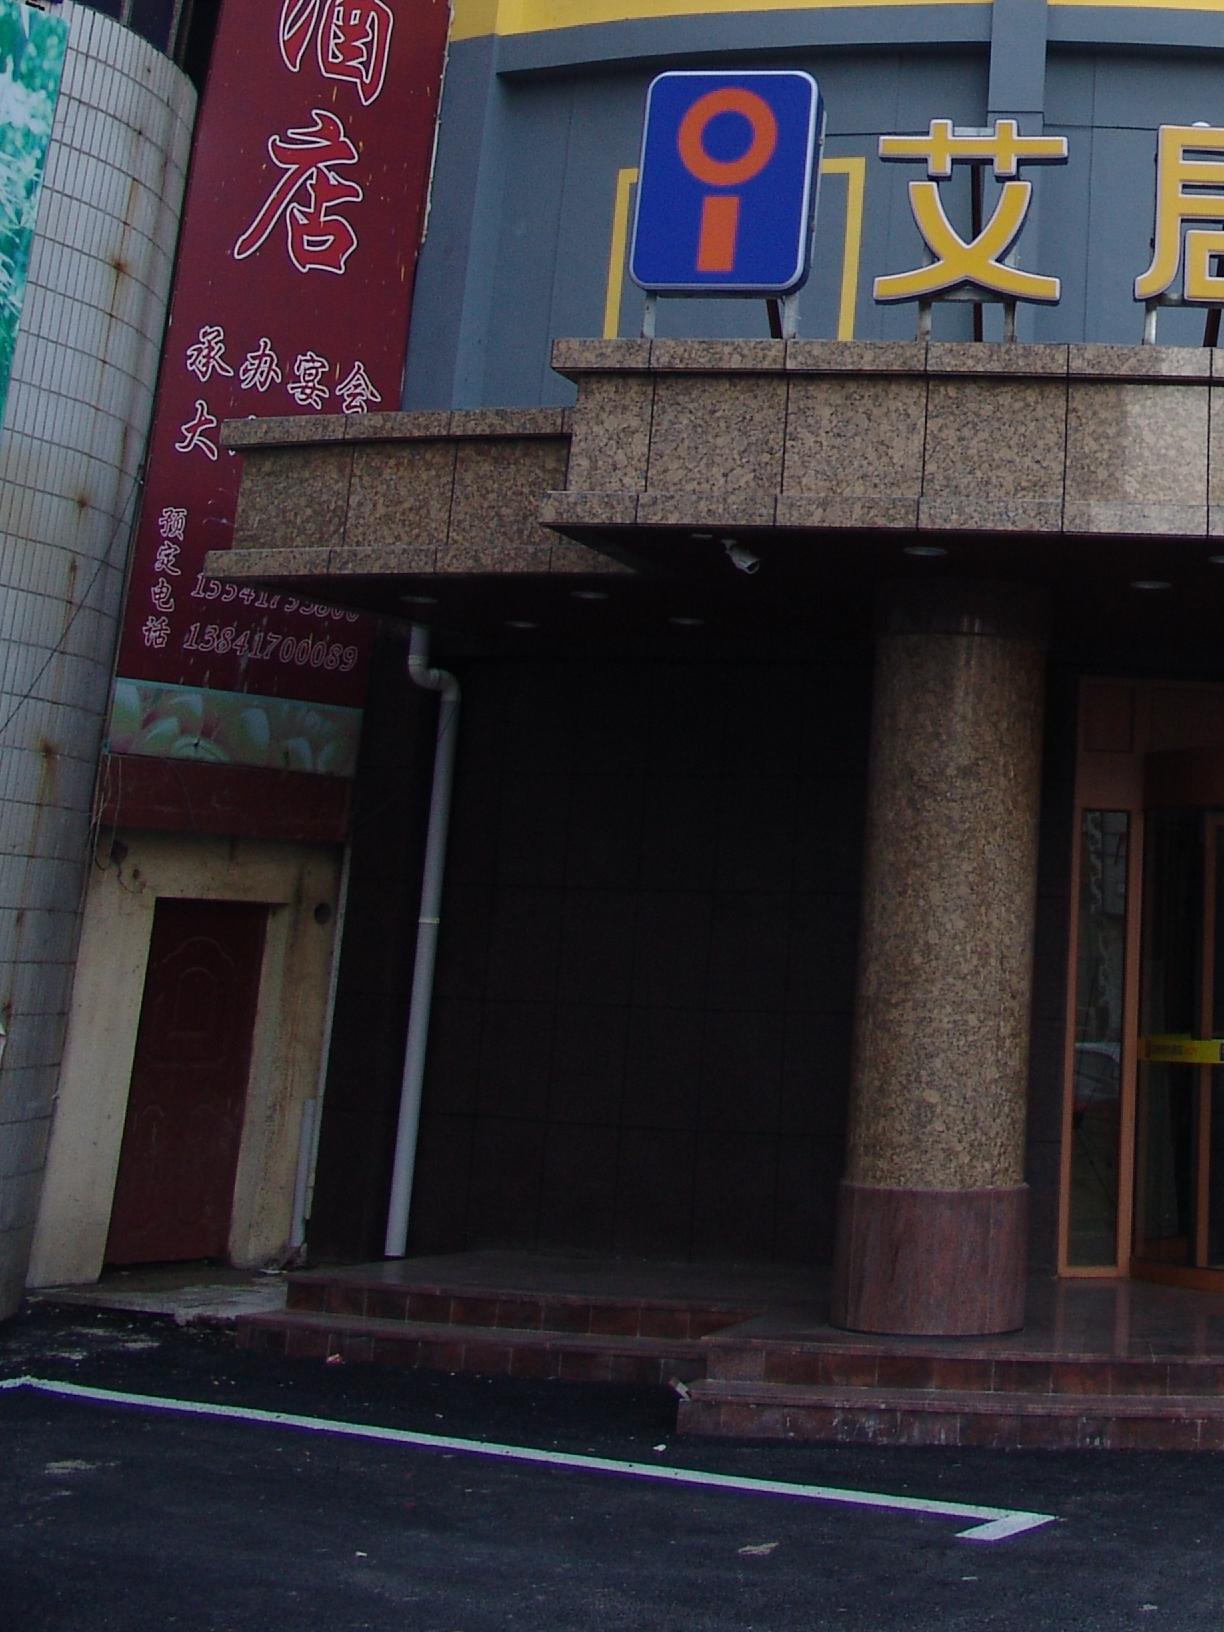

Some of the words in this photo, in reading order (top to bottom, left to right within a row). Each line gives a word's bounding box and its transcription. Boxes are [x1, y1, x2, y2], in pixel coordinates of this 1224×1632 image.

[186, 325, 382, 415] 承办宴会
[142, 506, 188, 649] 预定电话
[183, 621, 359, 672] 13841700089
